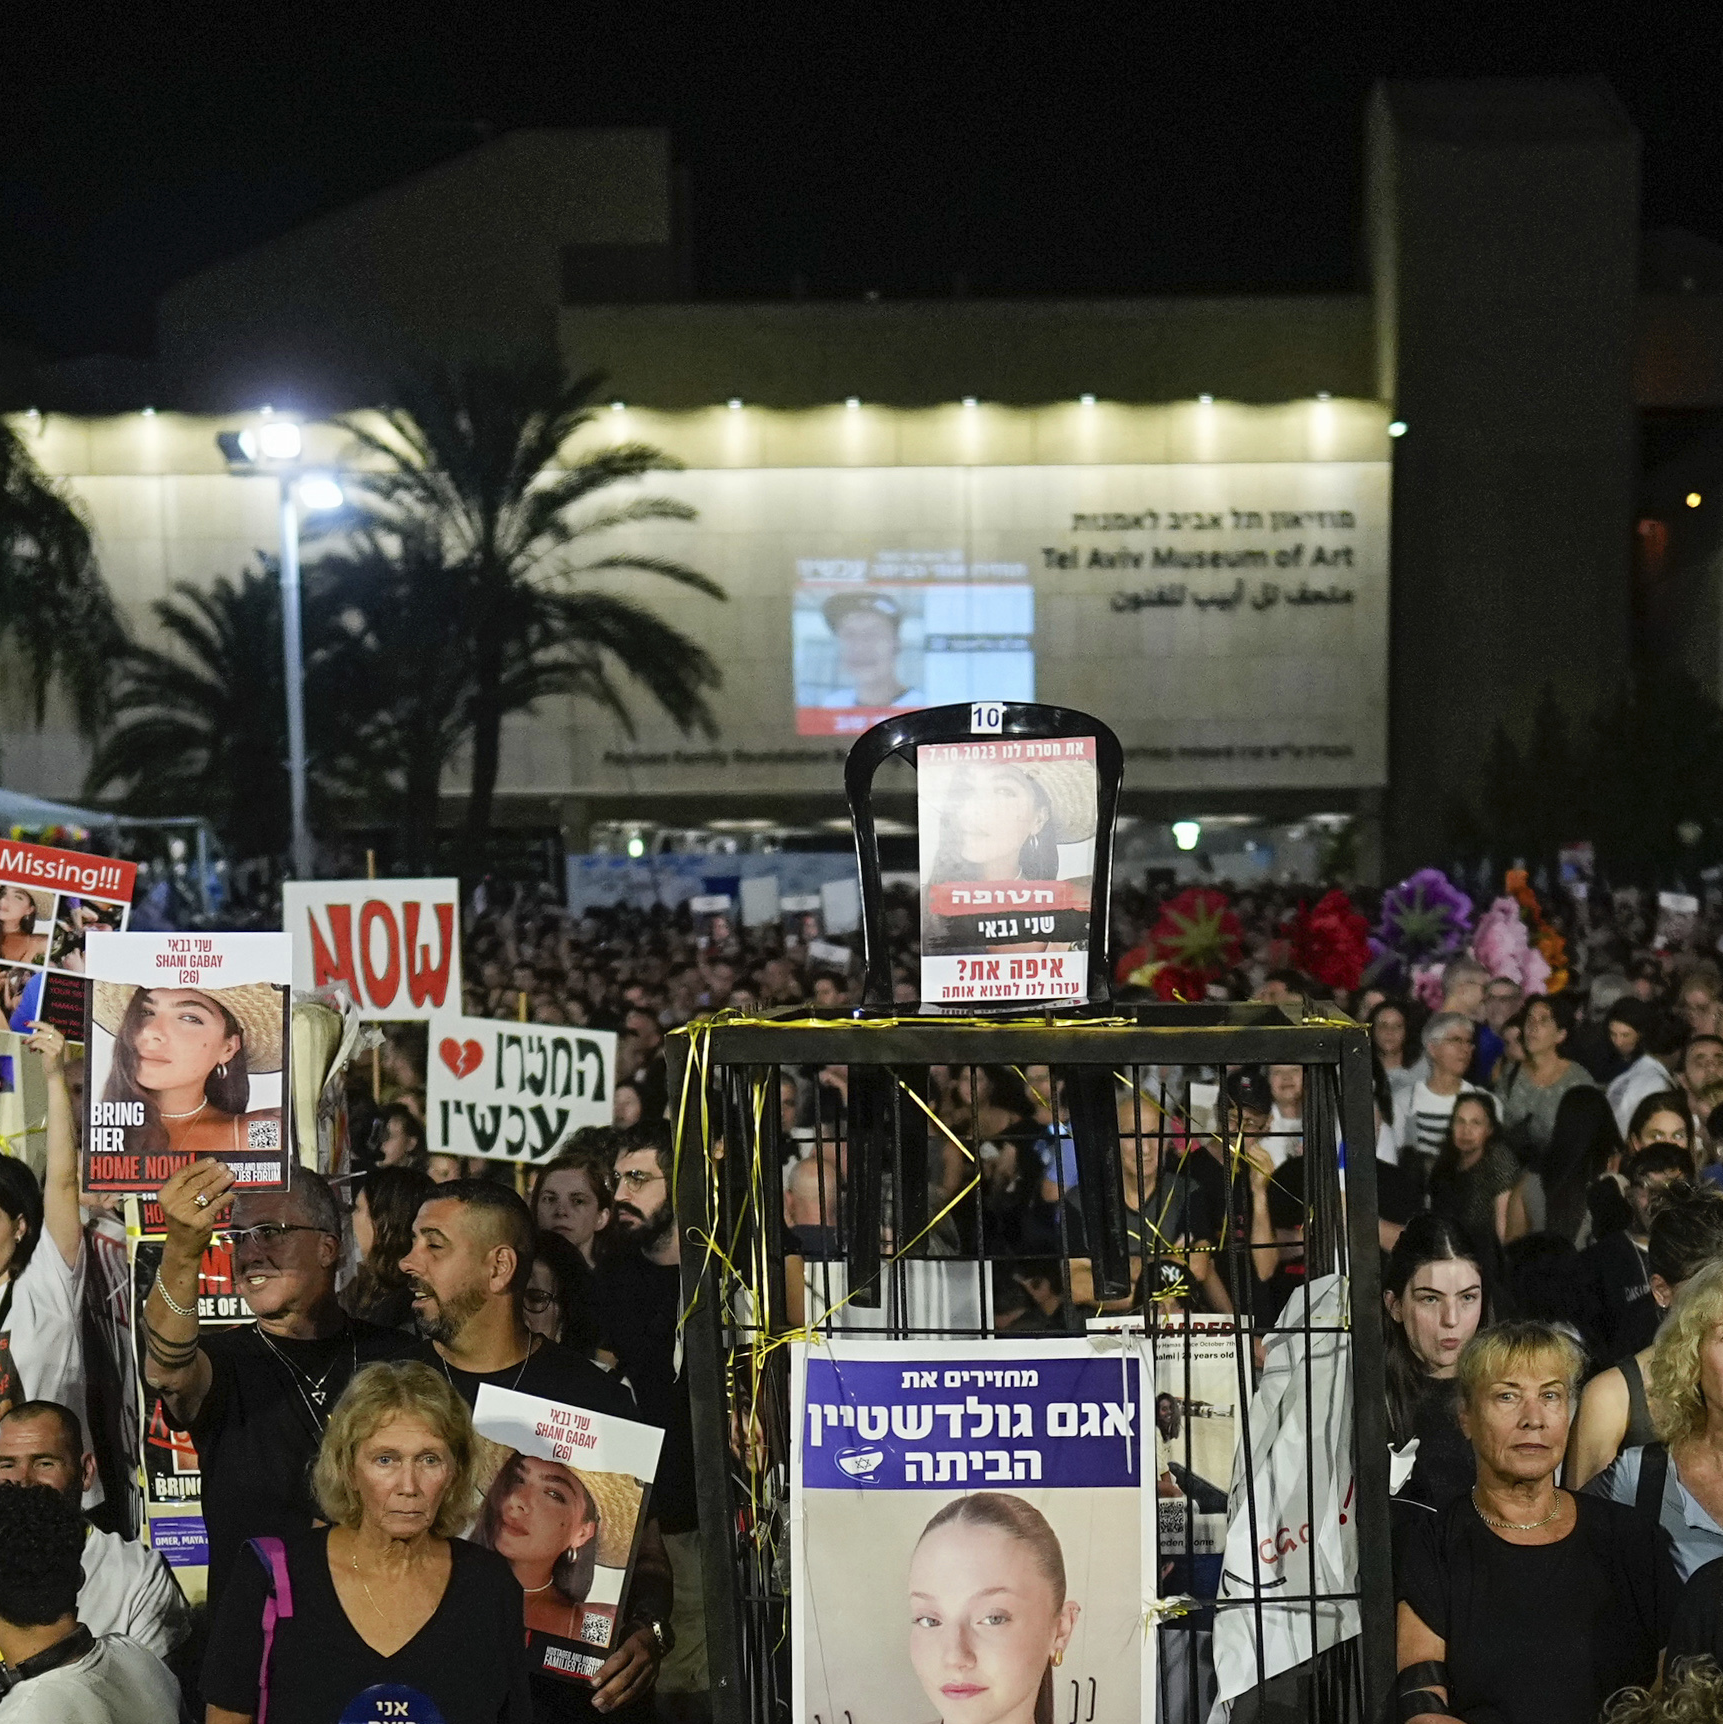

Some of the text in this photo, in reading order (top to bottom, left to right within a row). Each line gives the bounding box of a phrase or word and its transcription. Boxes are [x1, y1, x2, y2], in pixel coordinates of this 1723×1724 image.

[1042, 543, 1355, 569] Tel Aviv Museum of Art
[973, 707, 1000, 729] 10
[929, 742, 1085, 763] את חסרה לנו 7.10.2023
[0, 848, 122, 891] Missing!!!
[951, 889, 1055, 905] חטופה
[978, 915, 1056, 940] שני גבאי
[167, 938, 213, 953] שני גבאי
[305, 899, 455, 1010] NOW
[155, 953, 224, 969] SHANI GABAY
[957, 957, 1064, 981] איפה את?
[179, 969, 200, 985] (26)
[941, 984, 975, 999] אותה
[1025, 982, 1046, 997] לנו
[1050, 981, 1080, 996] עזרו
[495, 1031, 607, 1103] החזירו
[90, 1102, 145, 1127] BRING
[439, 1098, 571, 1157] עכשיו
[90, 1127, 125, 1153] HER
[89, 1155, 141, 1181] HOME
[252, 1170, 282, 1183] FORUM
[217, 1299, 239, 1317] OF
[1162, 1340, 1236, 1349] Hamas October 7th
[1193, 1353, 1219, 1362] years
[1220, 1351, 1235, 1361] old
[901, 1368, 1040, 1390] מחזירים את
[550, 1408, 591, 1431] שני גבאי
[807, 1395, 1136, 1448] אגם גולדשטיין
[535, 1422, 598, 1450] SHANI GABAY
[552, 1442, 573, 1462] (26)
[904, 1449, 1043, 1482] הביתה
[155, 1535, 205, 1547] OMER, MAYA
[1193, 1538, 1214, 1547] ome
[543, 1654, 599, 1678] FAMILIES FORU
[376, 1701, 409, 1717] אני
